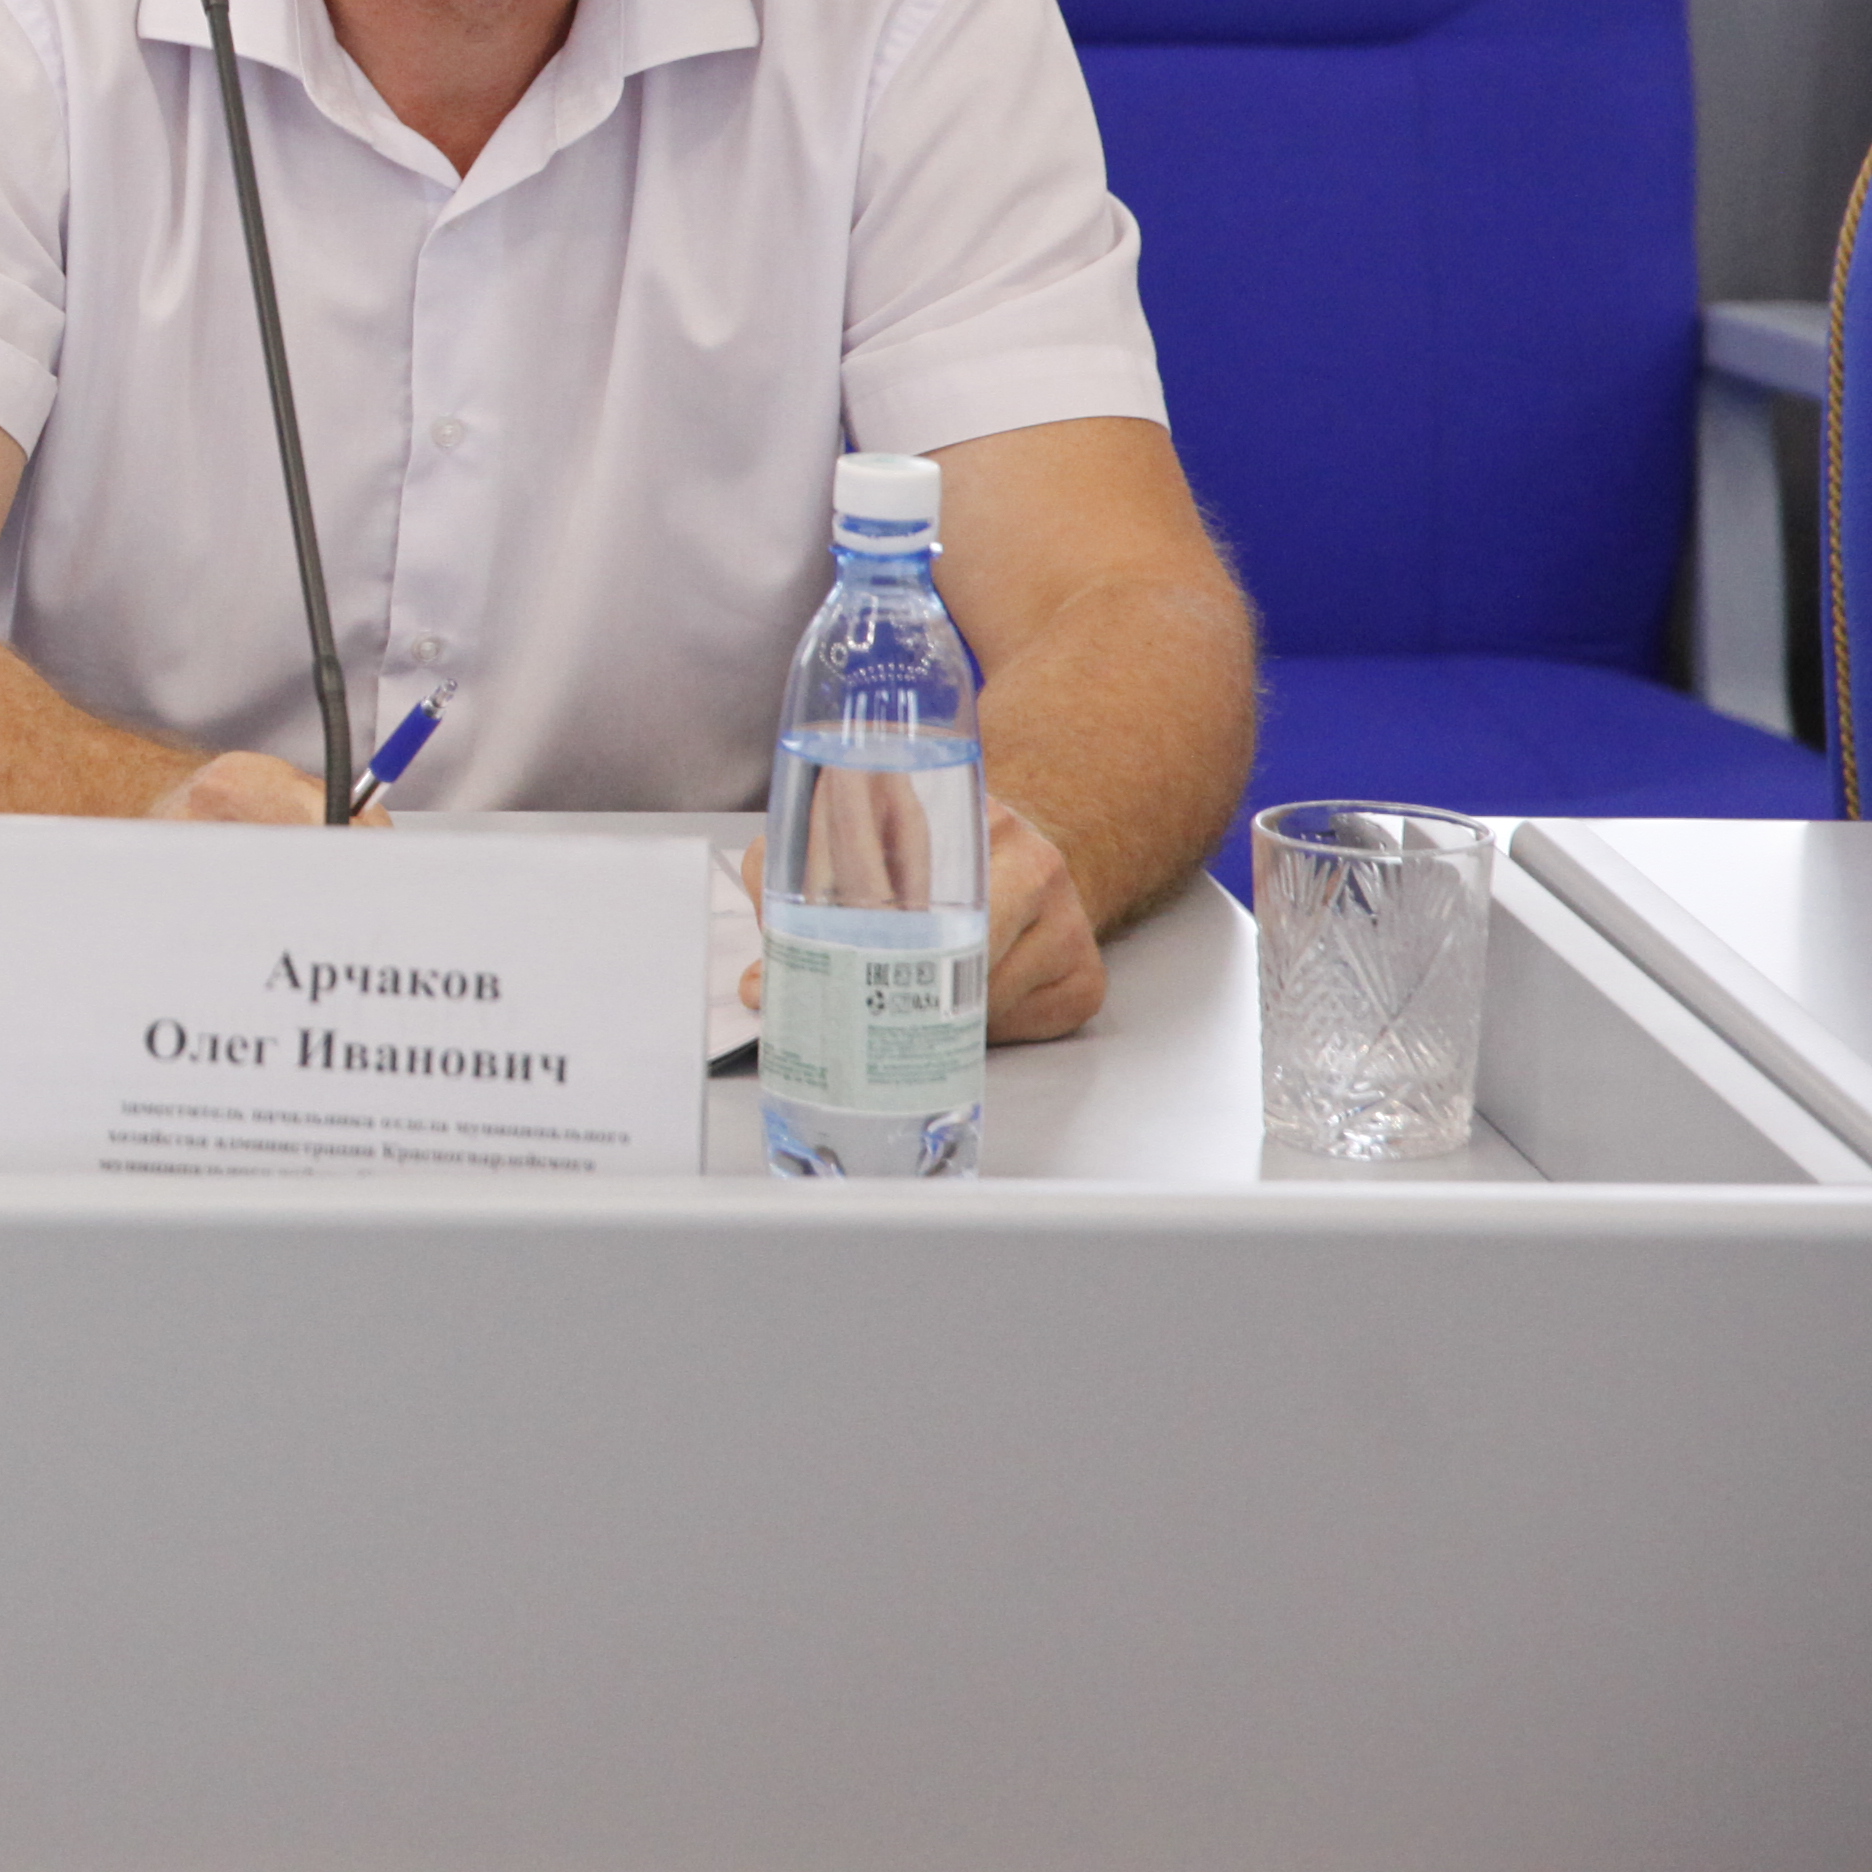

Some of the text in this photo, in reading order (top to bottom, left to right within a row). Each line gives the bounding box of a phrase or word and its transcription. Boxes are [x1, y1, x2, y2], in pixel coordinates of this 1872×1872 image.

[264, 947, 503, 1004] Арчаков
[143, 1017, 570, 1085] Олег Иванович
